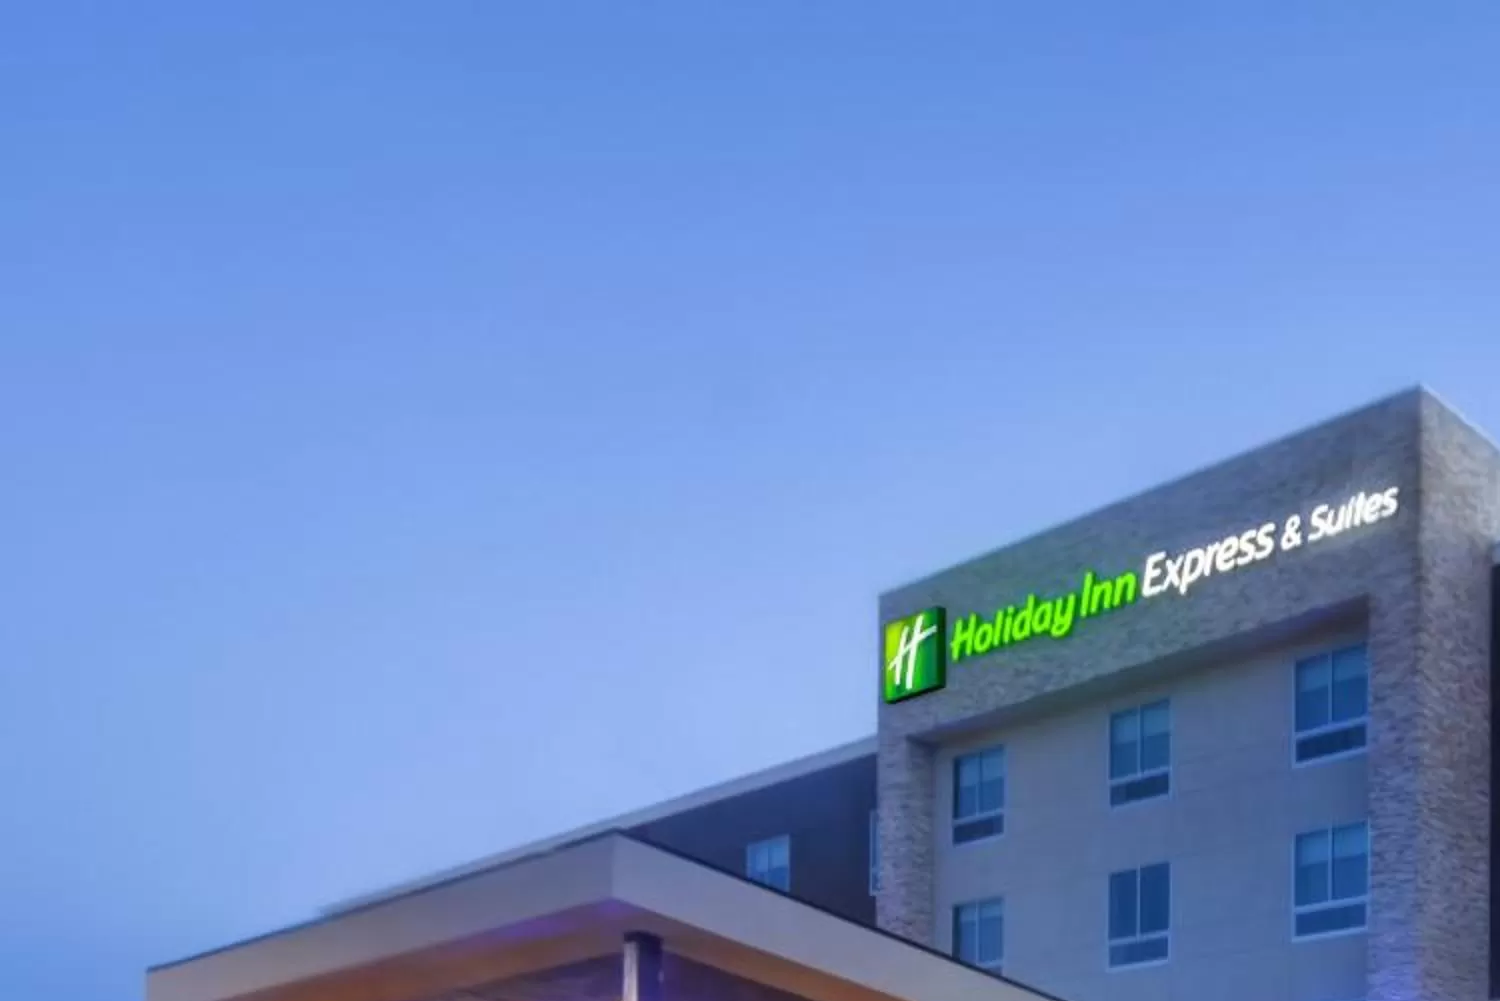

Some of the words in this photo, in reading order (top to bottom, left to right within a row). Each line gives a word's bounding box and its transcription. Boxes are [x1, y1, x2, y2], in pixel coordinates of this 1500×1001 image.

[950, 593, 1077, 661] Holiday
[1080, 570, 1138, 618] Inn
[1141, 521, 1276, 598] Express
[1281, 513, 1302, 551] &
[1307, 486, 1399, 543] Suites
